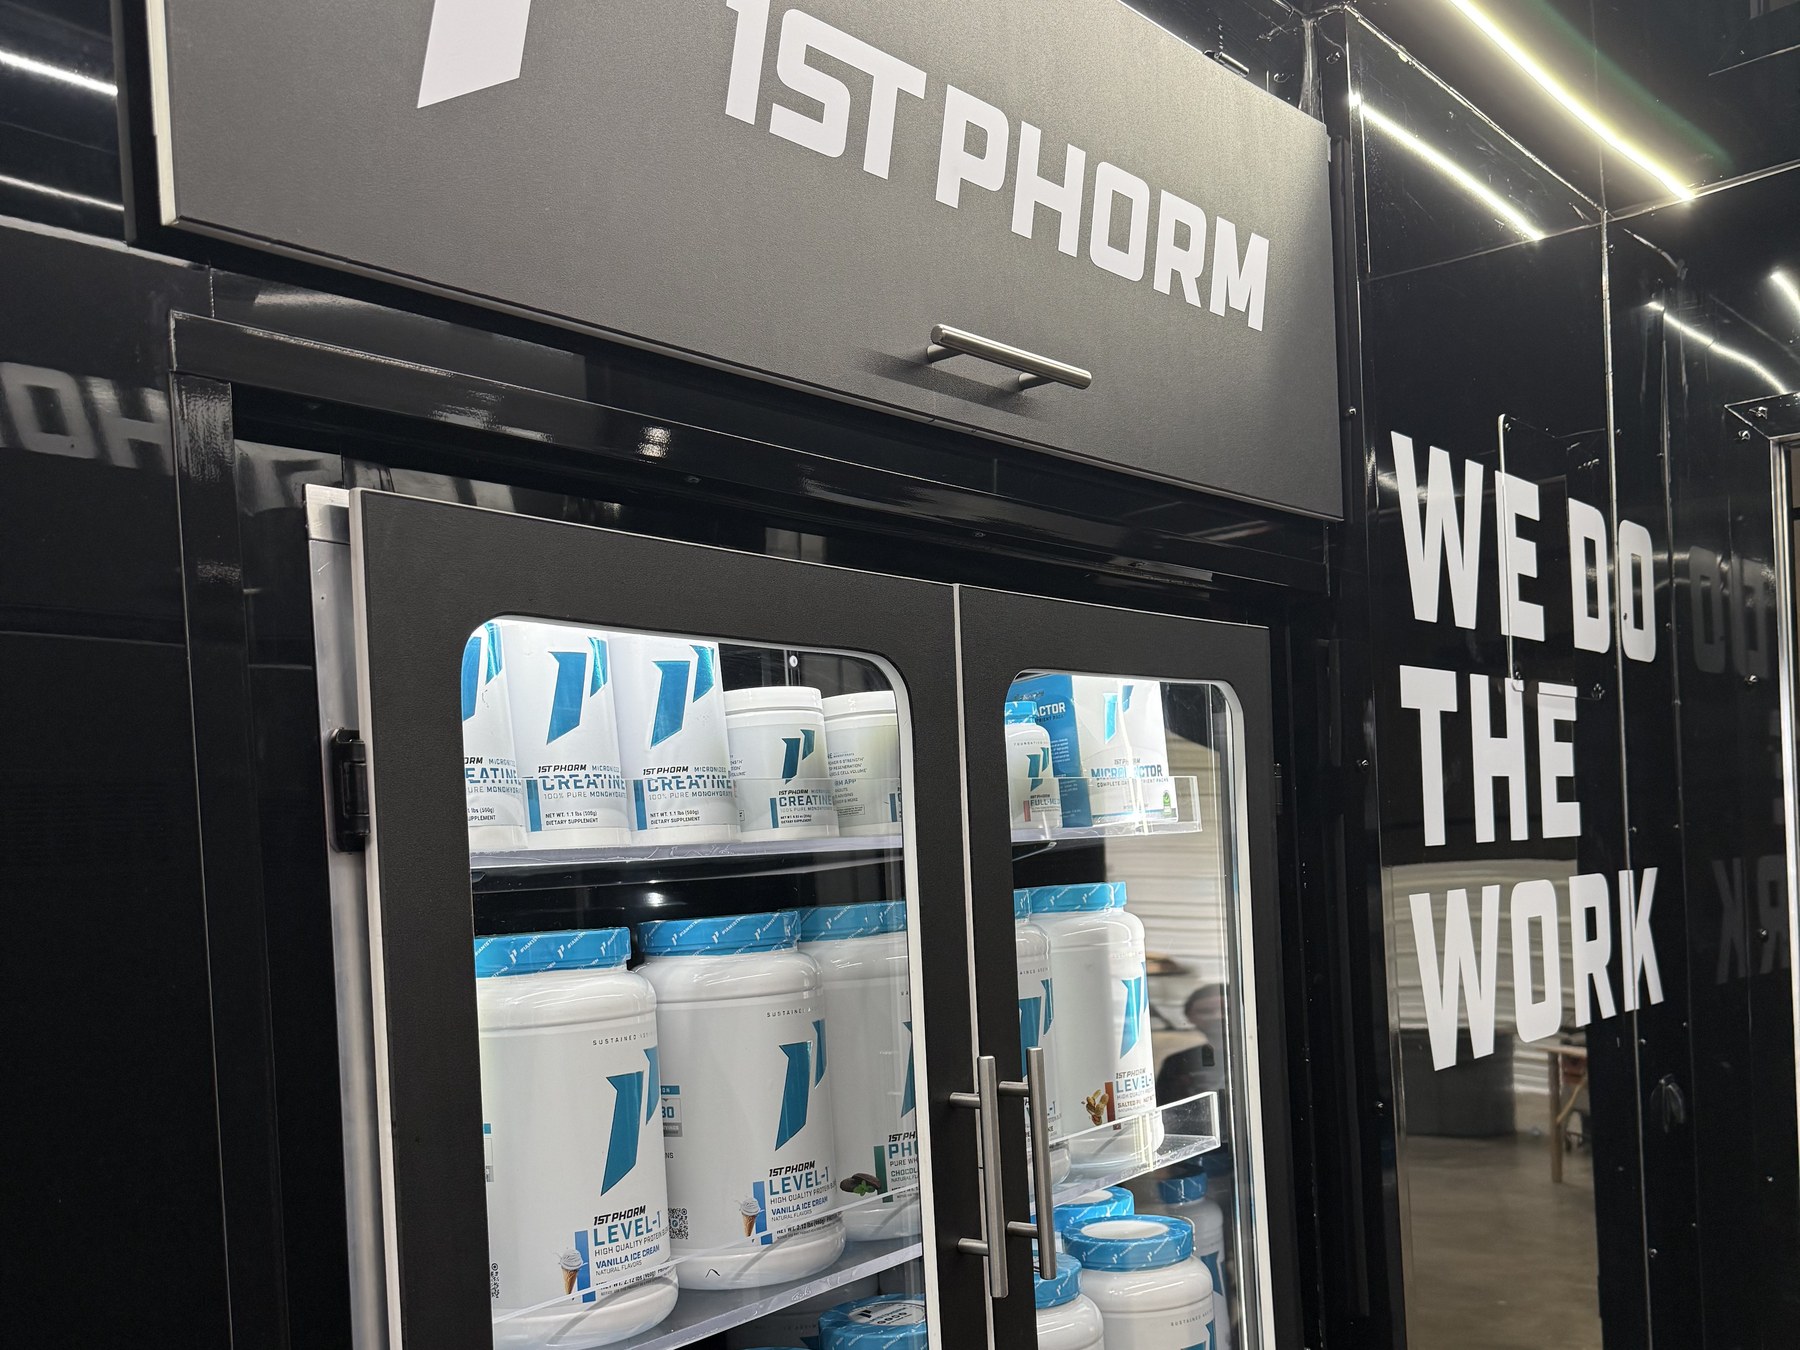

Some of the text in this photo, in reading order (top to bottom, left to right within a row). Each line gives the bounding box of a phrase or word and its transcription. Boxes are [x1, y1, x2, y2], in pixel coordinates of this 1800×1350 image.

[725, 0, 1270, 333] 1ST PHORM
[1391, 430, 1657, 663] WE DO
[464, 757, 484, 765] ORM
[1399, 664, 1582, 847] THE
[538, 765, 553, 774] 1ST
[553, 763, 587, 772] PHORM
[643, 767, 656, 776] 1ST
[656, 765, 689, 775] PHORM
[538, 773, 626, 791] CREATINE
[644, 774, 733, 793] CREATINE
[467, 786, 484, 794] URE
[543, 791, 564, 800] 100%
[566, 791, 588, 799] PURE
[779, 795, 832, 807] CREATINE
[468, 814, 496, 822] UPPLEMENT
[545, 811, 556, 819] NET
[567, 817, 599, 825] SUPPLEMENT
[650, 816, 701, 826] DIETARY SUPPLEMENT
[1408, 866, 1665, 1072] WORK
[592, 1033, 638, 1046] SUSTAINED
[888, 1132, 903, 1143] 1ST
[768, 1159, 816, 1178] 1ST PHORM
[889, 1159, 907, 1168] PURE
[890, 1167, 919, 1178] CHOCOL
[768, 1166, 829, 1196] LEVEL-1
[770, 1196, 788, 1205] HIGH
[788, 1189, 813, 1202] QUALITY
[771, 1196, 829, 1216] VANILLA ICE CREAM
[593, 1204, 647, 1226] 1ST PHORM
[771, 1209, 813, 1222] NATURAL FLAVORS
[593, 1209, 662, 1247] LEVEL-1
[594, 1246, 614, 1257] HIGH
[615, 1239, 643, 1253] QUALITY
[643, 1232, 662, 1245] PROTEIN
[595, 1243, 661, 1269] VANILLA ICE CREAM
[595, 1259, 643, 1276] NATURAL FLAVORS
